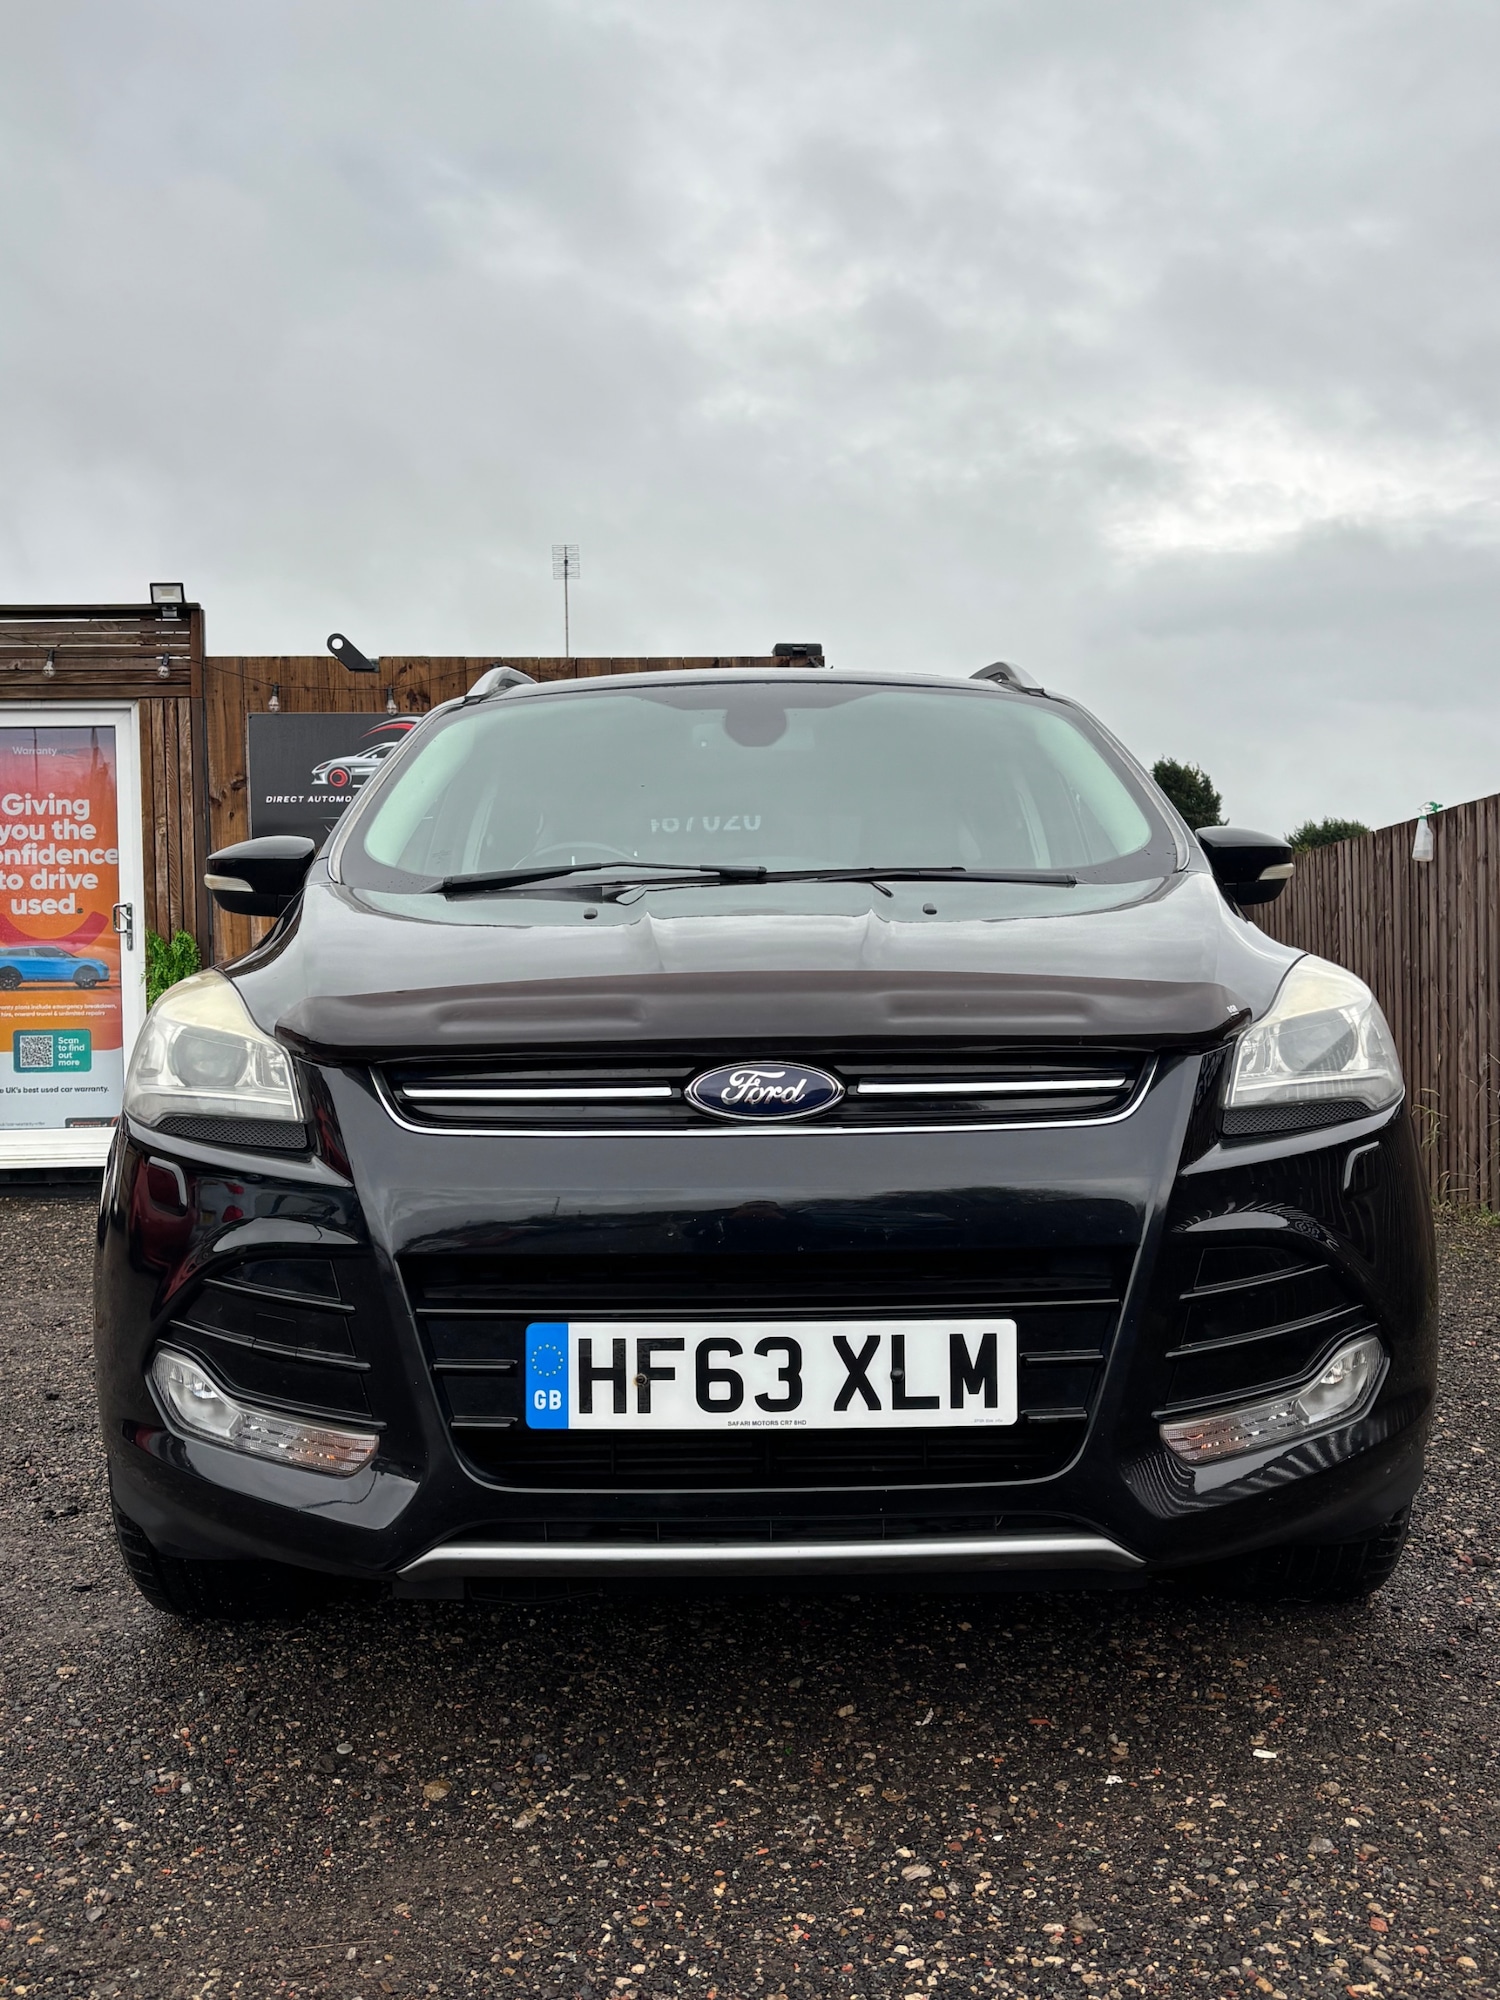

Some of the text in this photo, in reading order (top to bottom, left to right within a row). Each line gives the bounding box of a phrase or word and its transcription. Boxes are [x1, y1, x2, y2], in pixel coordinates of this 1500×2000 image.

[1, 793, 90, 821] Giving
[265, 795, 354, 803] DIRECT AUTOMO
[0, 819, 97, 845] you the
[0, 867, 99, 890] to drive
[58, 1044, 85, 1052] to find
[74, 1085, 110, 1093] warranty.
[720, 1069, 808, 1106] Ford
[578, 1333, 998, 1415] HF63 XLM
[533, 1389, 562, 1411] GB
